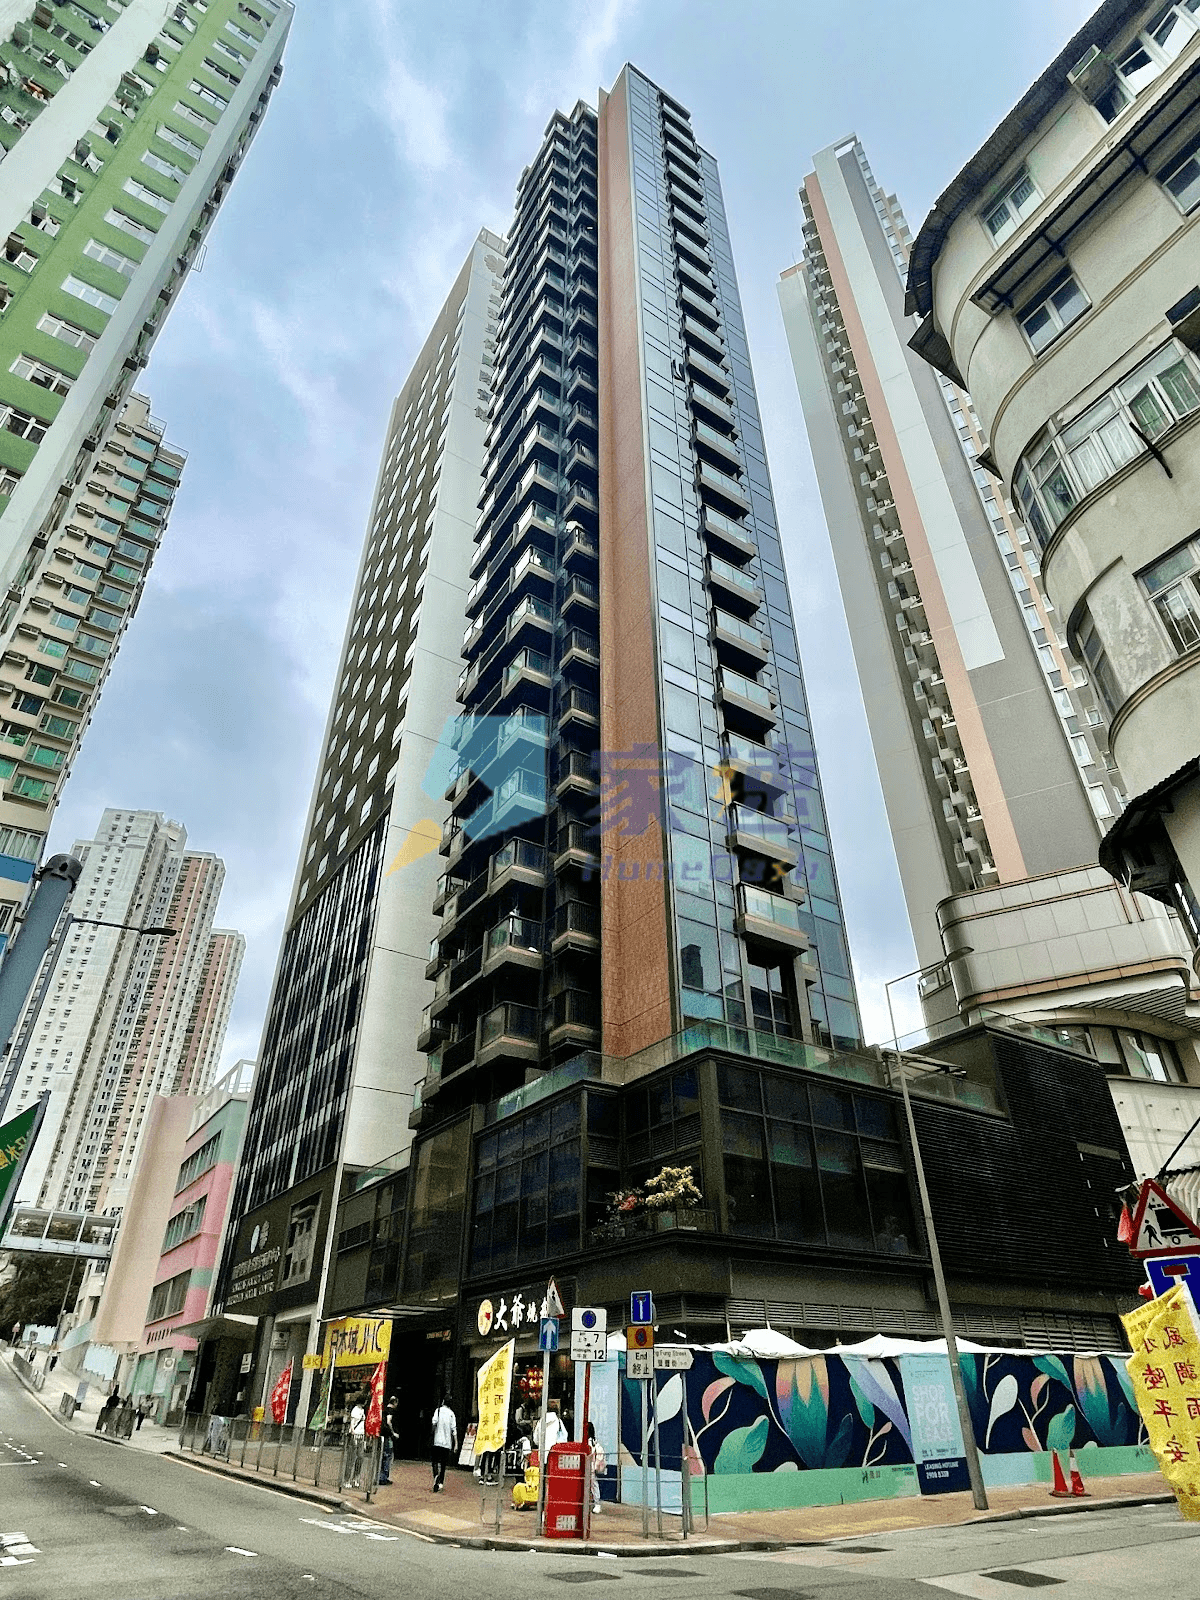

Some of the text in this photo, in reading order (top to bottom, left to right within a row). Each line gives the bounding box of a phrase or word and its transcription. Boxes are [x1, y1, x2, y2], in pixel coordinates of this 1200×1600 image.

[358, 1319, 385, 1355] JHC
[593, 1334, 600, 1344] 7
[593, 1349, 604, 1360] 12
[635, 1352, 648, 1360] End
[632, 1363, 650, 1375] 終止
[911, 1384, 946, 1402] SHOP
[913, 1402, 951, 1426] FOR
